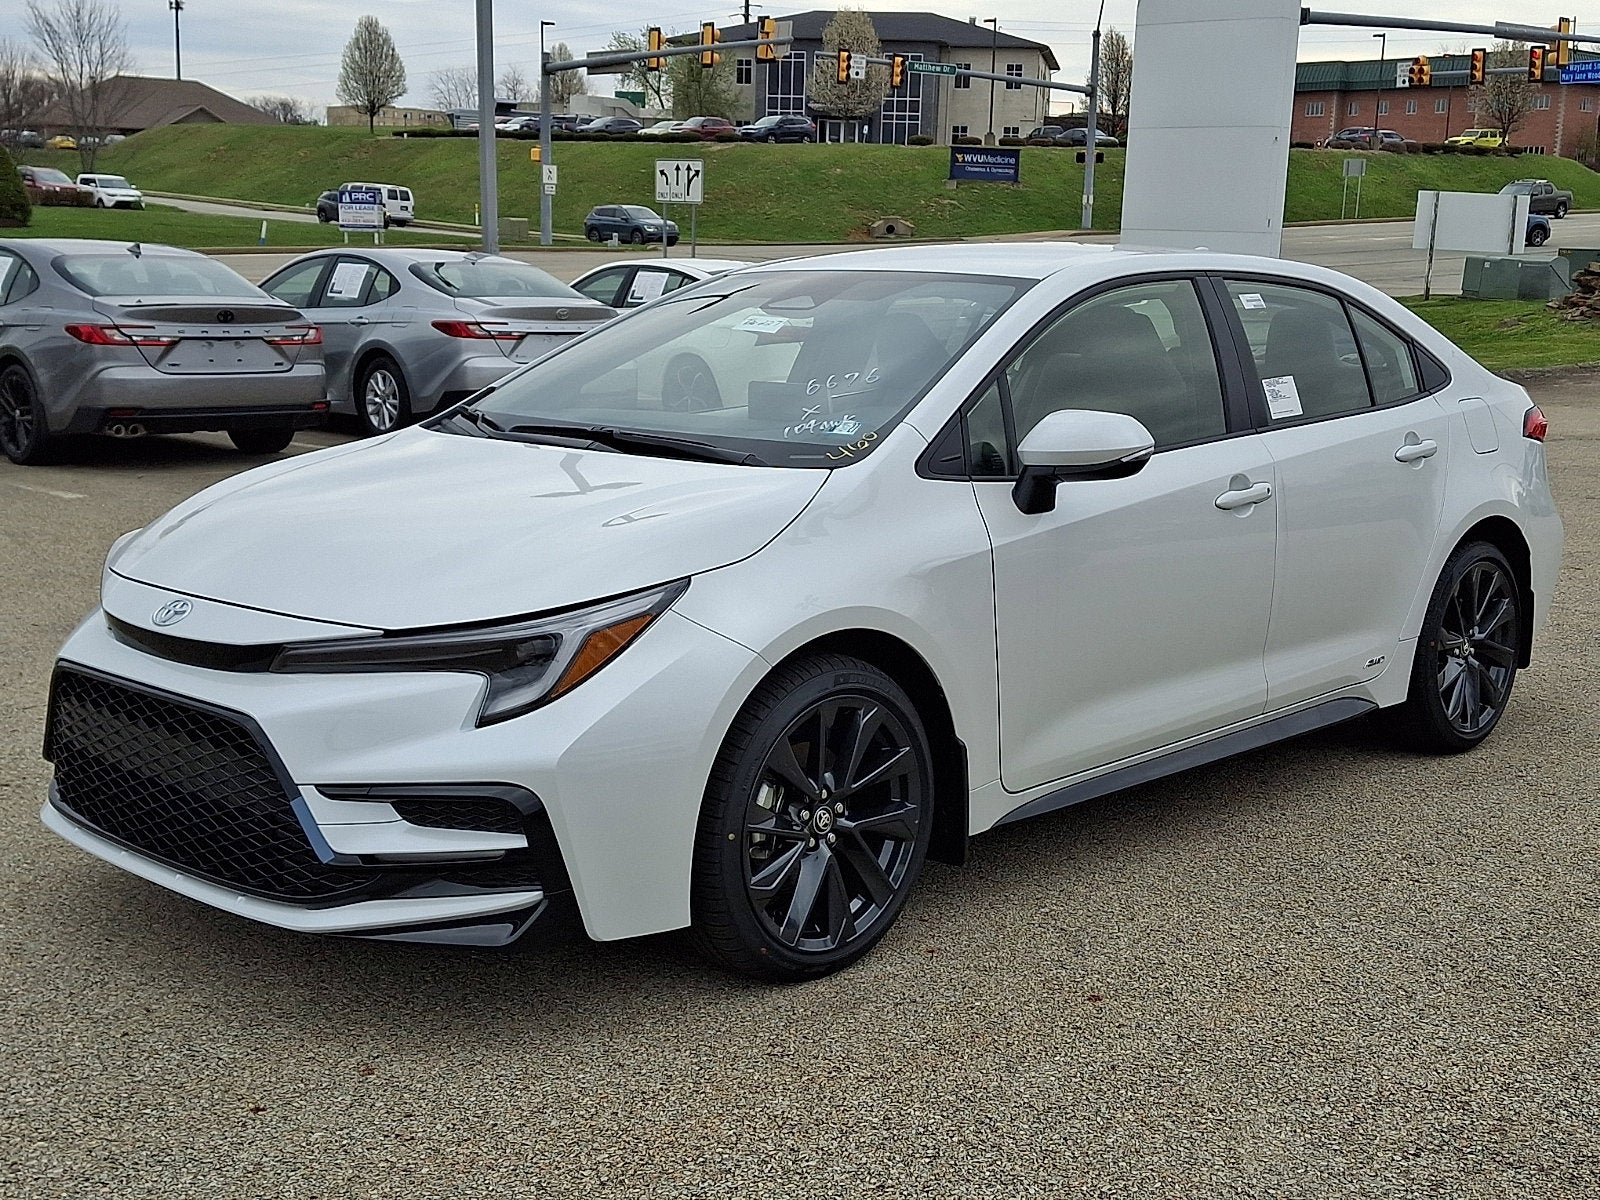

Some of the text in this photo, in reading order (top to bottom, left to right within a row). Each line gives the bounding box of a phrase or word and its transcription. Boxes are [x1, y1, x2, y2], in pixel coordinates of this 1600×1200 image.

[913, 63, 941, 72] Matthew
[1570, 63, 1592, 72] Wayland
[1562, 73, 1573, 82] Mary
[1575, 72, 1586, 80] Jane
[351, 192, 375, 201] PRC
[806, 367, 881, 396] 6676
